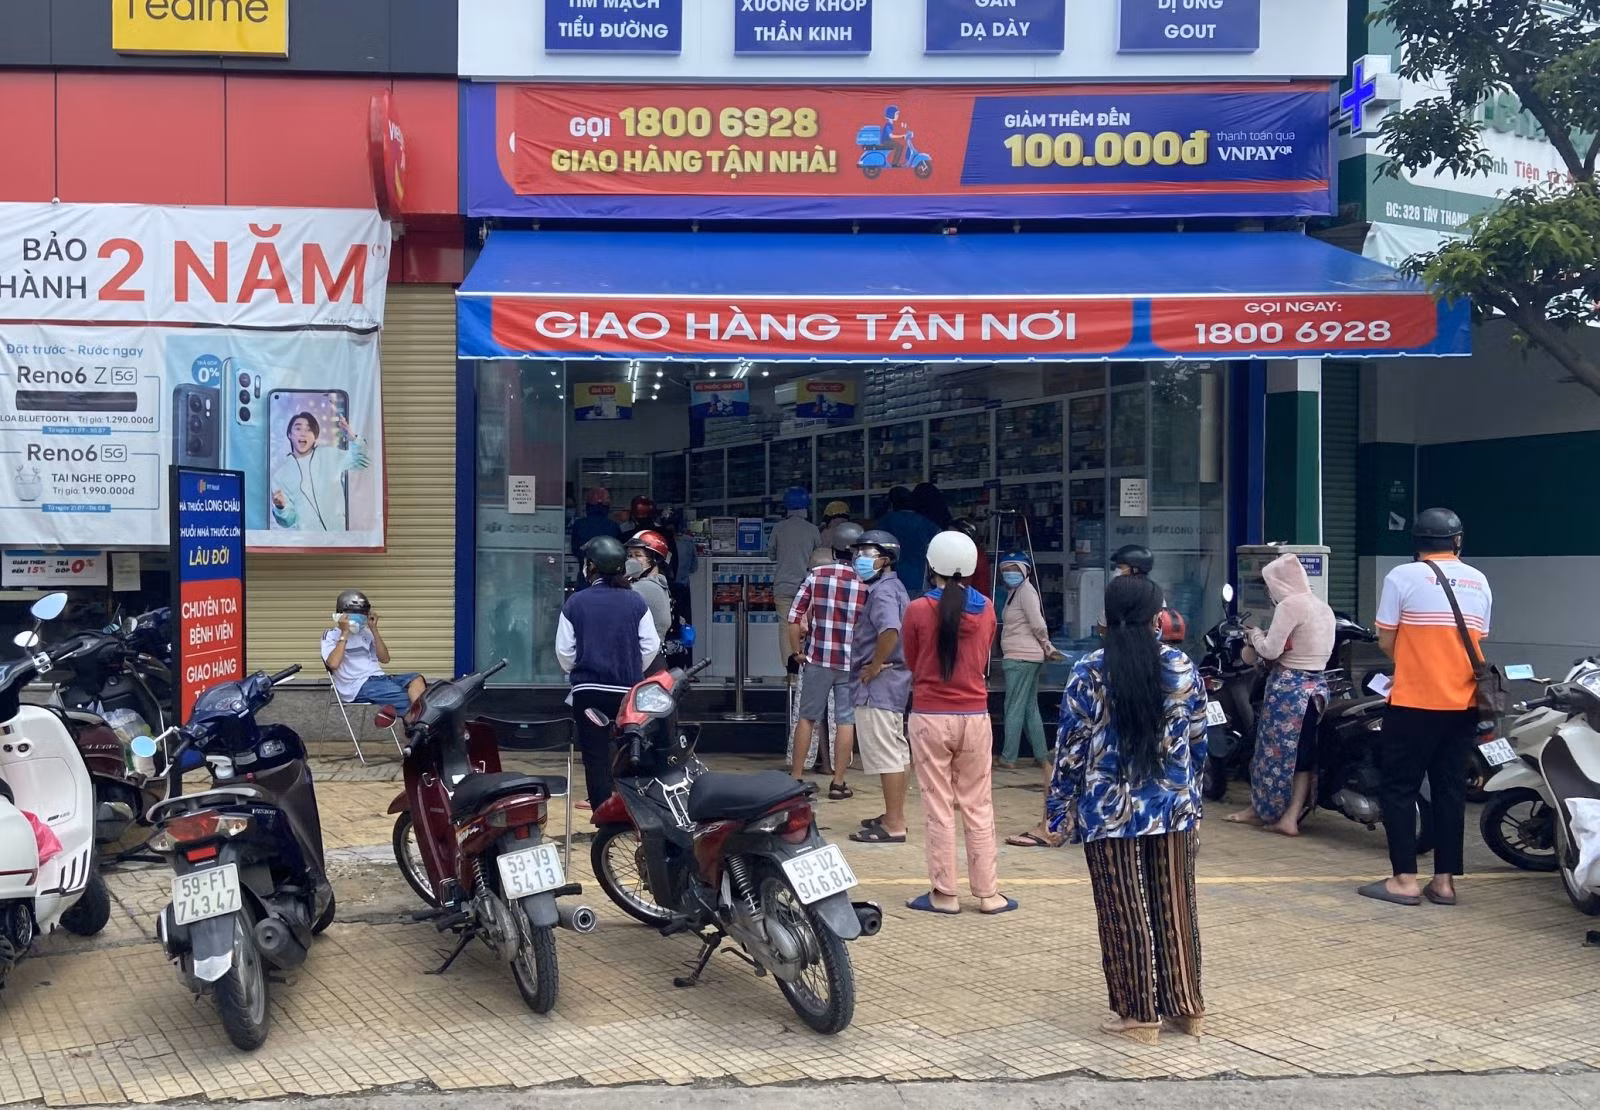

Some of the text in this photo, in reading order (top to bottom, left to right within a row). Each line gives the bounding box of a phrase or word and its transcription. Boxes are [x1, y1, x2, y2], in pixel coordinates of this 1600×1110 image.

[129, 0, 269, 23] realme
[558, 15, 669, 38] TIỂU ĐƯỜNG
[754, 20, 852, 41] THẦN KINH
[960, 18, 1031, 41] DẠ DÀY
[1164, 24, 1217, 39] GOUT
[569, 106, 819, 142] GỌI 1800 6928
[1004, 107, 1131, 128] GIẢM THÊM ĐẾN
[1216, 130, 1296, 143] thanh toán qua
[1003, 129, 1211, 168] 100.000đ
[551, 144, 837, 179] GIAO HÀNG TẬN NHÀ!
[1514, 160, 1540, 183] Tiện
[1403, 204, 1420, 221] 328
[1423, 205, 1439, 224] TÂY
[23, 231, 87, 262] BẢO
[97, 238, 145, 302] 2
[174, 223, 368, 305] NĂM
[0, 268, 87, 299] HÀNH
[1244, 301, 1342, 316] GỌI NGAY:
[535, 305, 1076, 350] GIAO HÀNG TẬN NƠI
[1194, 320, 1391, 345] 1800 6928
[6, 343, 29, 355] Đặt
[33, 344, 66, 355] trước
[78, 344, 110, 356] Rước
[112, 347, 144, 358] ngay
[17, 365, 134, 385] Reno6 Z 5G
[198, 367, 220, 383] 0%
[19, 415, 69, 423] BLUETOOTH
[27, 443, 124, 462] Reno6 5G
[51, 473, 136, 483] TAI NGHE OPPO
[205, 499, 222, 512] LONG
[223, 497, 240, 512] CHÂU
[189, 546, 210, 566] LÂU
[182, 595, 237, 619] CHUYÊN TOA
[189, 619, 234, 649] BỆNH VIỆN
[186, 656, 236, 683] GIAO HÀNG
[506, 848, 551, 874] 53-V9
[793, 851, 838, 879] 59-D2
[182, 870, 227, 898] 59-F1
[512, 867, 556, 893] 5413
[798, 867, 852, 899] 946.84
[178, 889, 235, 921] 743.47
